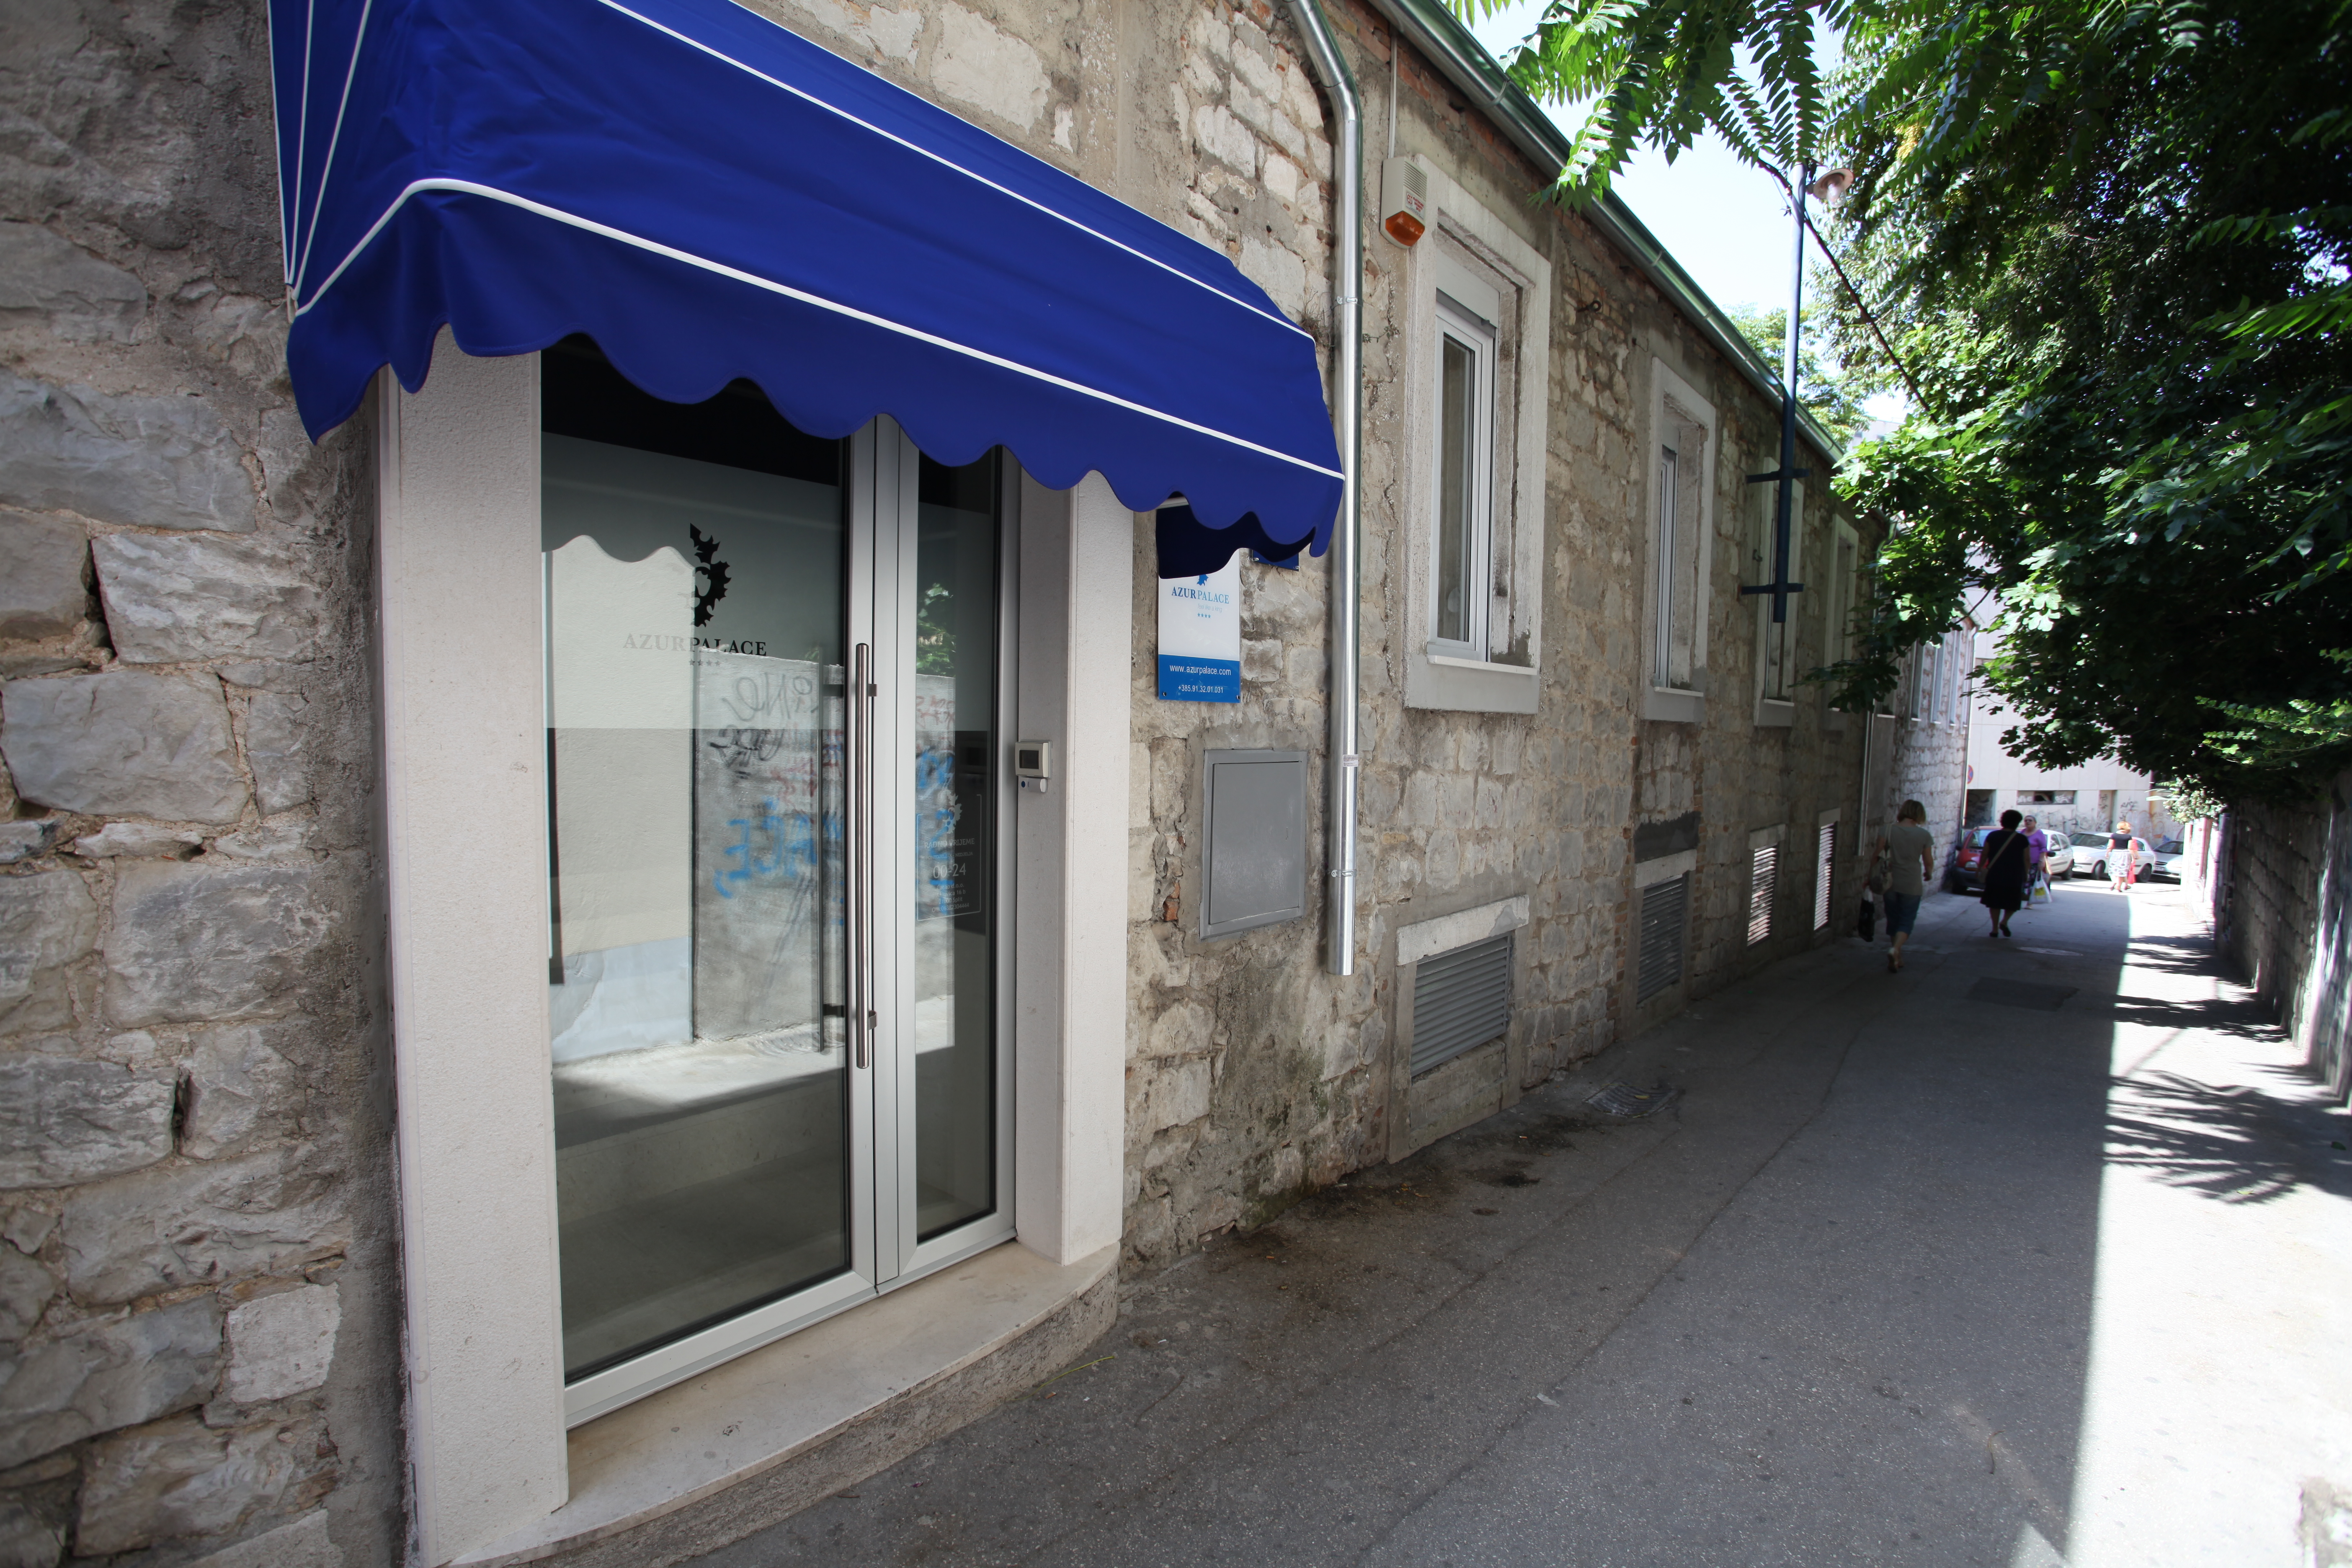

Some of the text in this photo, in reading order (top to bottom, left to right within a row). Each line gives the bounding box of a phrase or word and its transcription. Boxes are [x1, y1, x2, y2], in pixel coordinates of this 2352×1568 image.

[1169, 665, 1231, 676] www.azurpalace.com
[1178, 684, 1223, 693] +385.91.32.01.031
[924, 838, 975, 848] RADNO VRIJEME
[933, 863, 966, 879] 00-24
